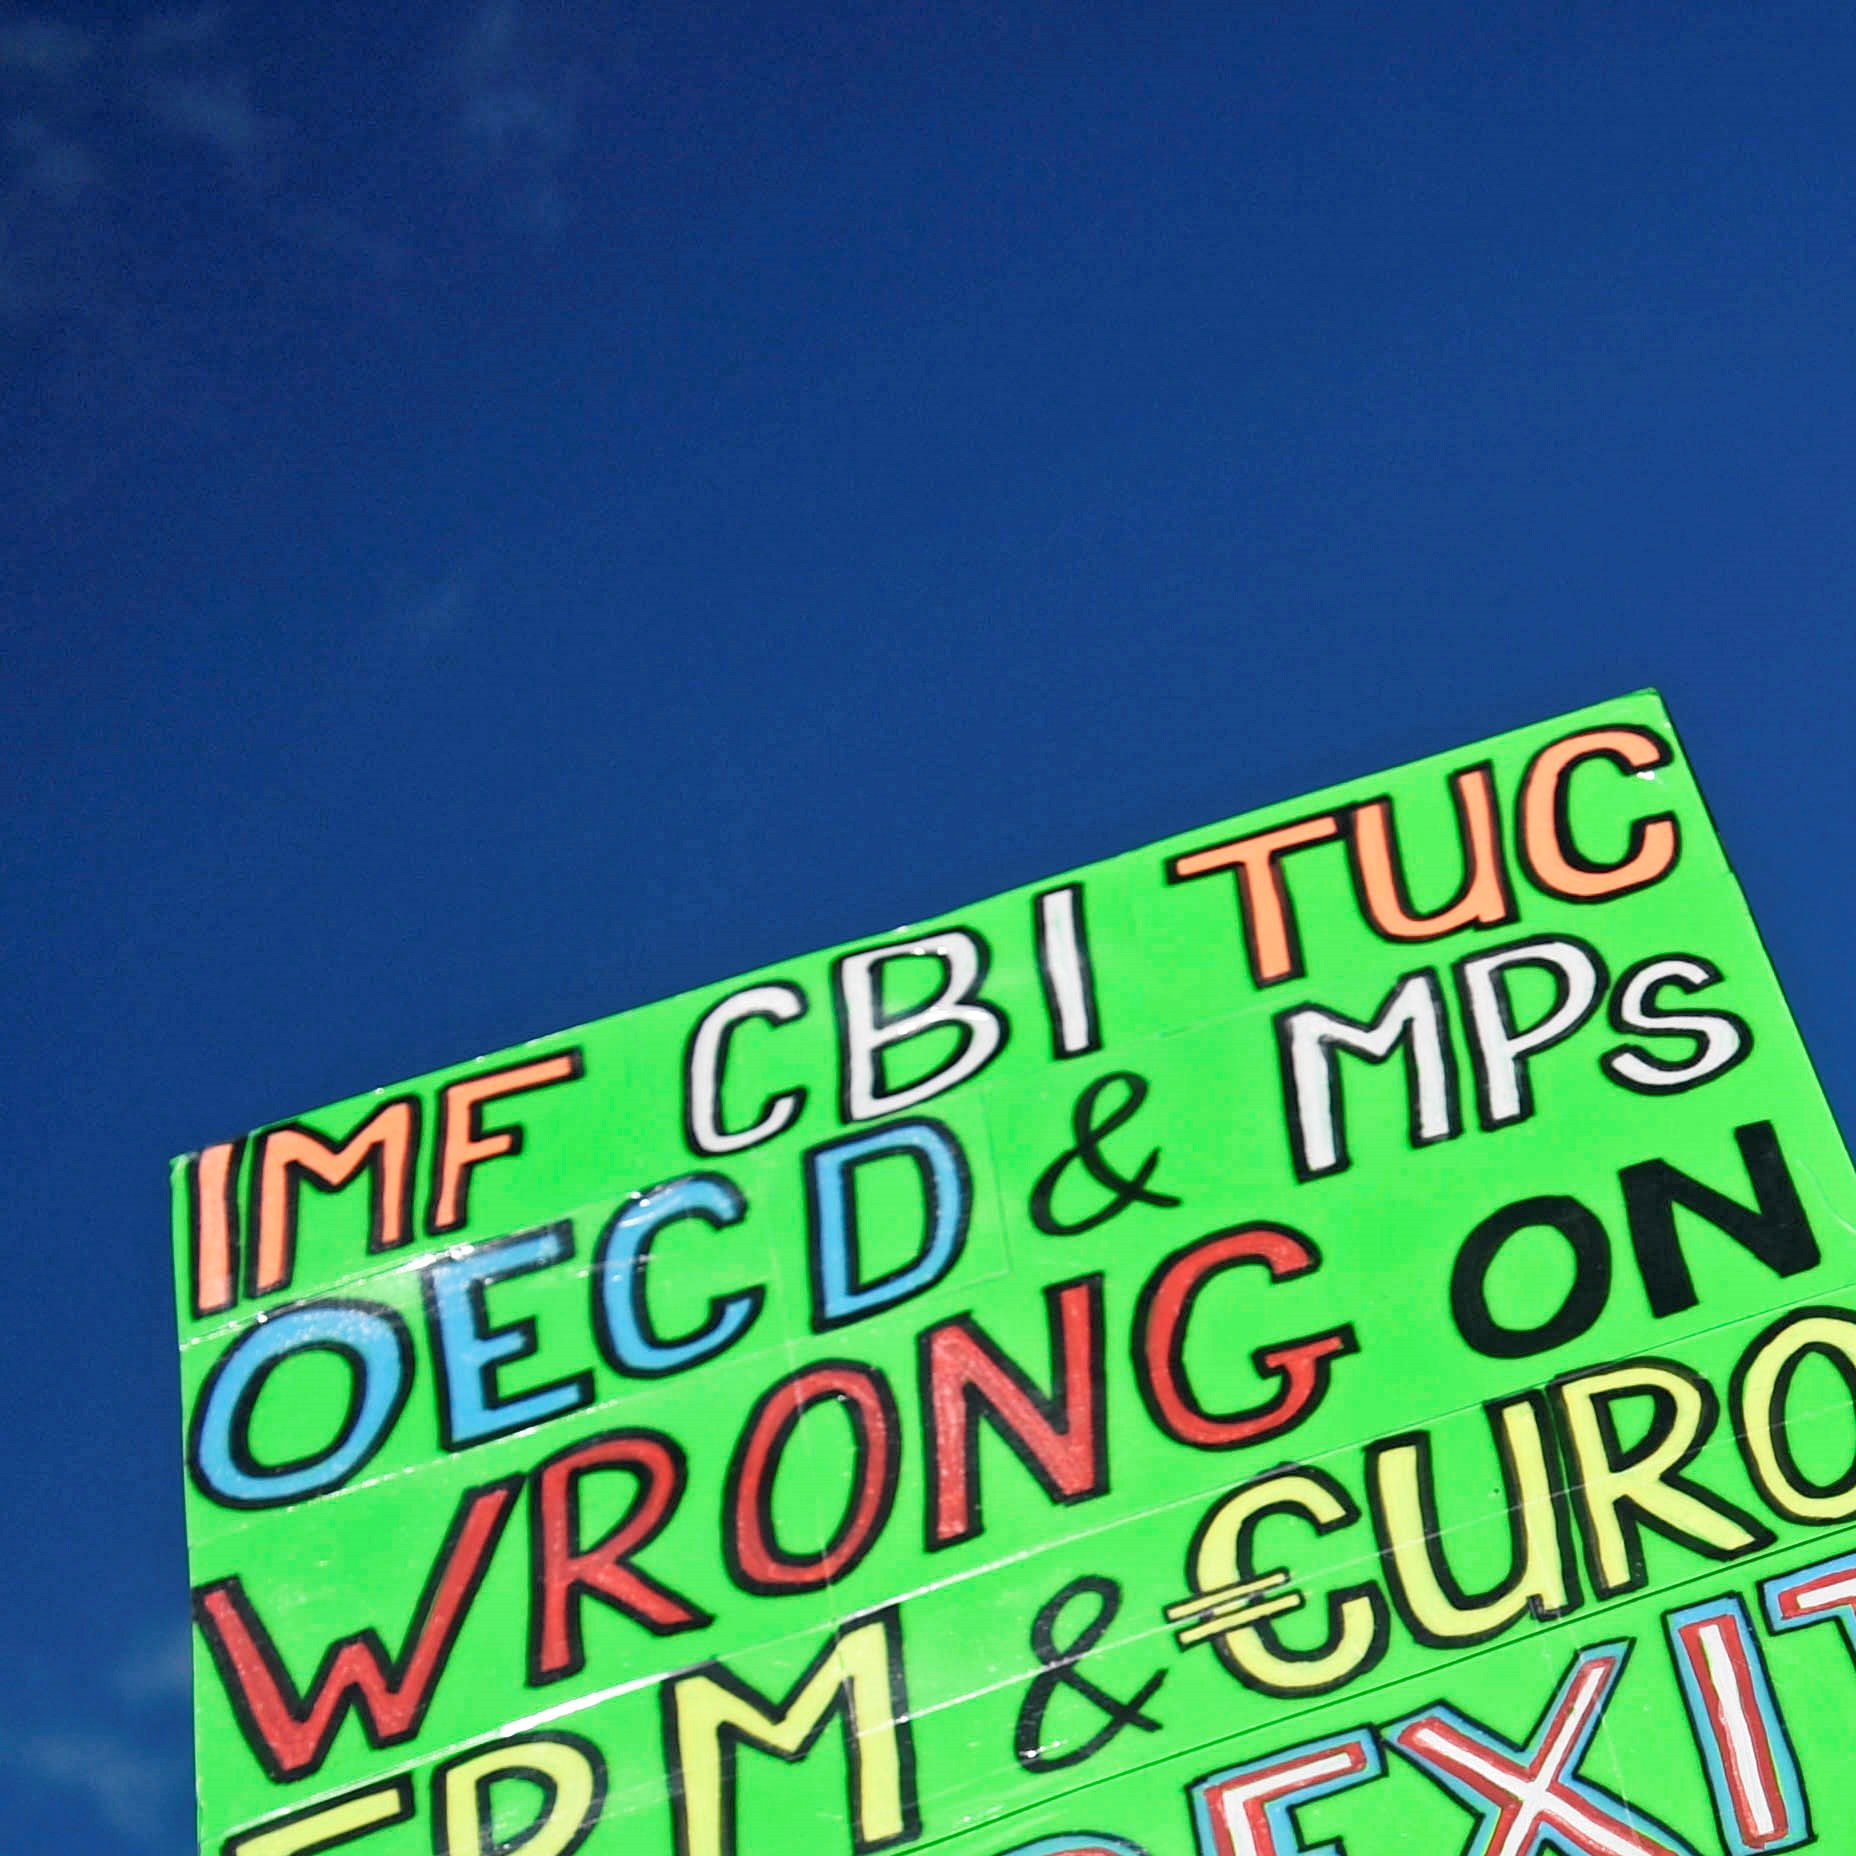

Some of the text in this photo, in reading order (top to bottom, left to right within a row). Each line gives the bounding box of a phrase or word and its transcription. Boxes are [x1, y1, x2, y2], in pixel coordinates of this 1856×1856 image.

[186, 723, 1680, 1315] IMF CBI TUC
[191, 1117, 973, 1509] OECD
[1030, 1070, 1183, 1237] &
[192, 1120, 1821, 1783] WRONG ON
[1014, 1575, 1170, 1774] &
